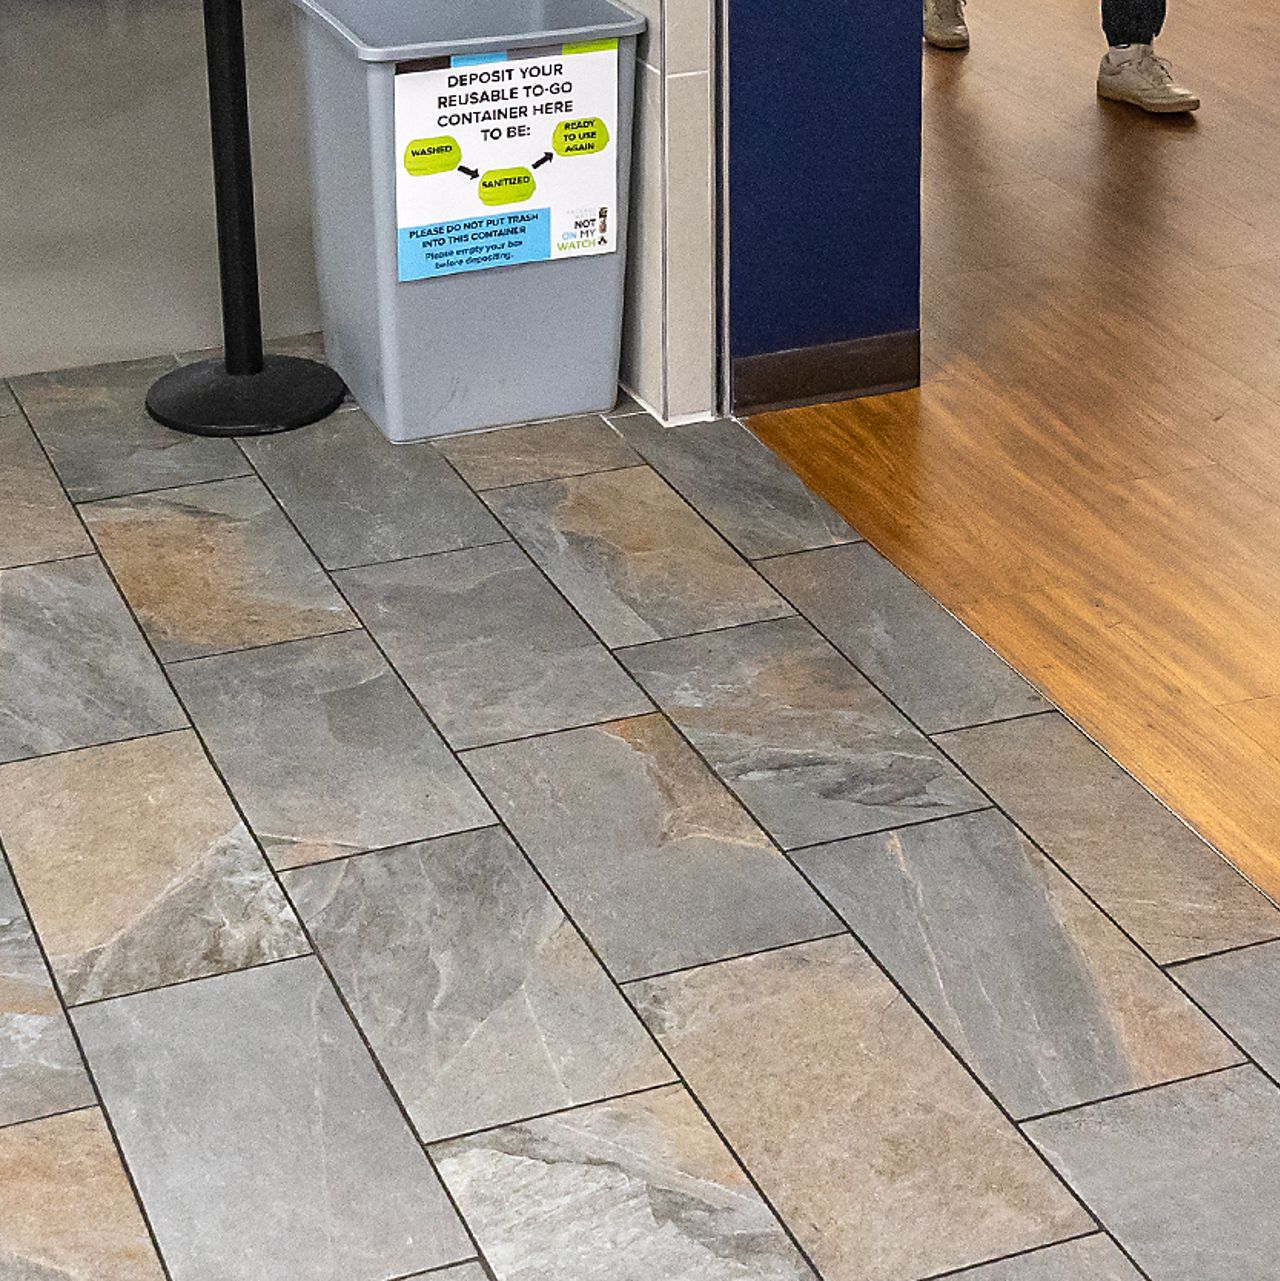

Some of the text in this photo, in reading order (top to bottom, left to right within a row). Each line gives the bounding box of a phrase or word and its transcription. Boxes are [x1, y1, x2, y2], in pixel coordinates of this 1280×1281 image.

[448, 63, 564, 87] DEPOSIT YOUR
[438, 81, 573, 108] REUSABLE TO-GO
[438, 100, 574, 127] CONTAINER HERE
[564, 120, 596, 130] READY
[481, 125, 531, 141] TO BE:
[563, 131, 597, 141] TO USE
[411, 145, 453, 157] WASHED
[564, 142, 595, 152] AGAIN
[482, 176, 531, 188] SANITIZED
[409, 214, 539, 239] PLEASE DO NOT PUT TRASH
[574, 218, 597, 229] NOT
[422, 227, 526, 248] INTO THIS CONTAINER
[562, 228, 597, 240] ON MY
[557, 238, 596, 250] WATCH
[425, 249, 455, 260] Please
[455, 246, 484, 258] empty
[485, 243, 507, 254] your
[435, 258, 464, 269] before
